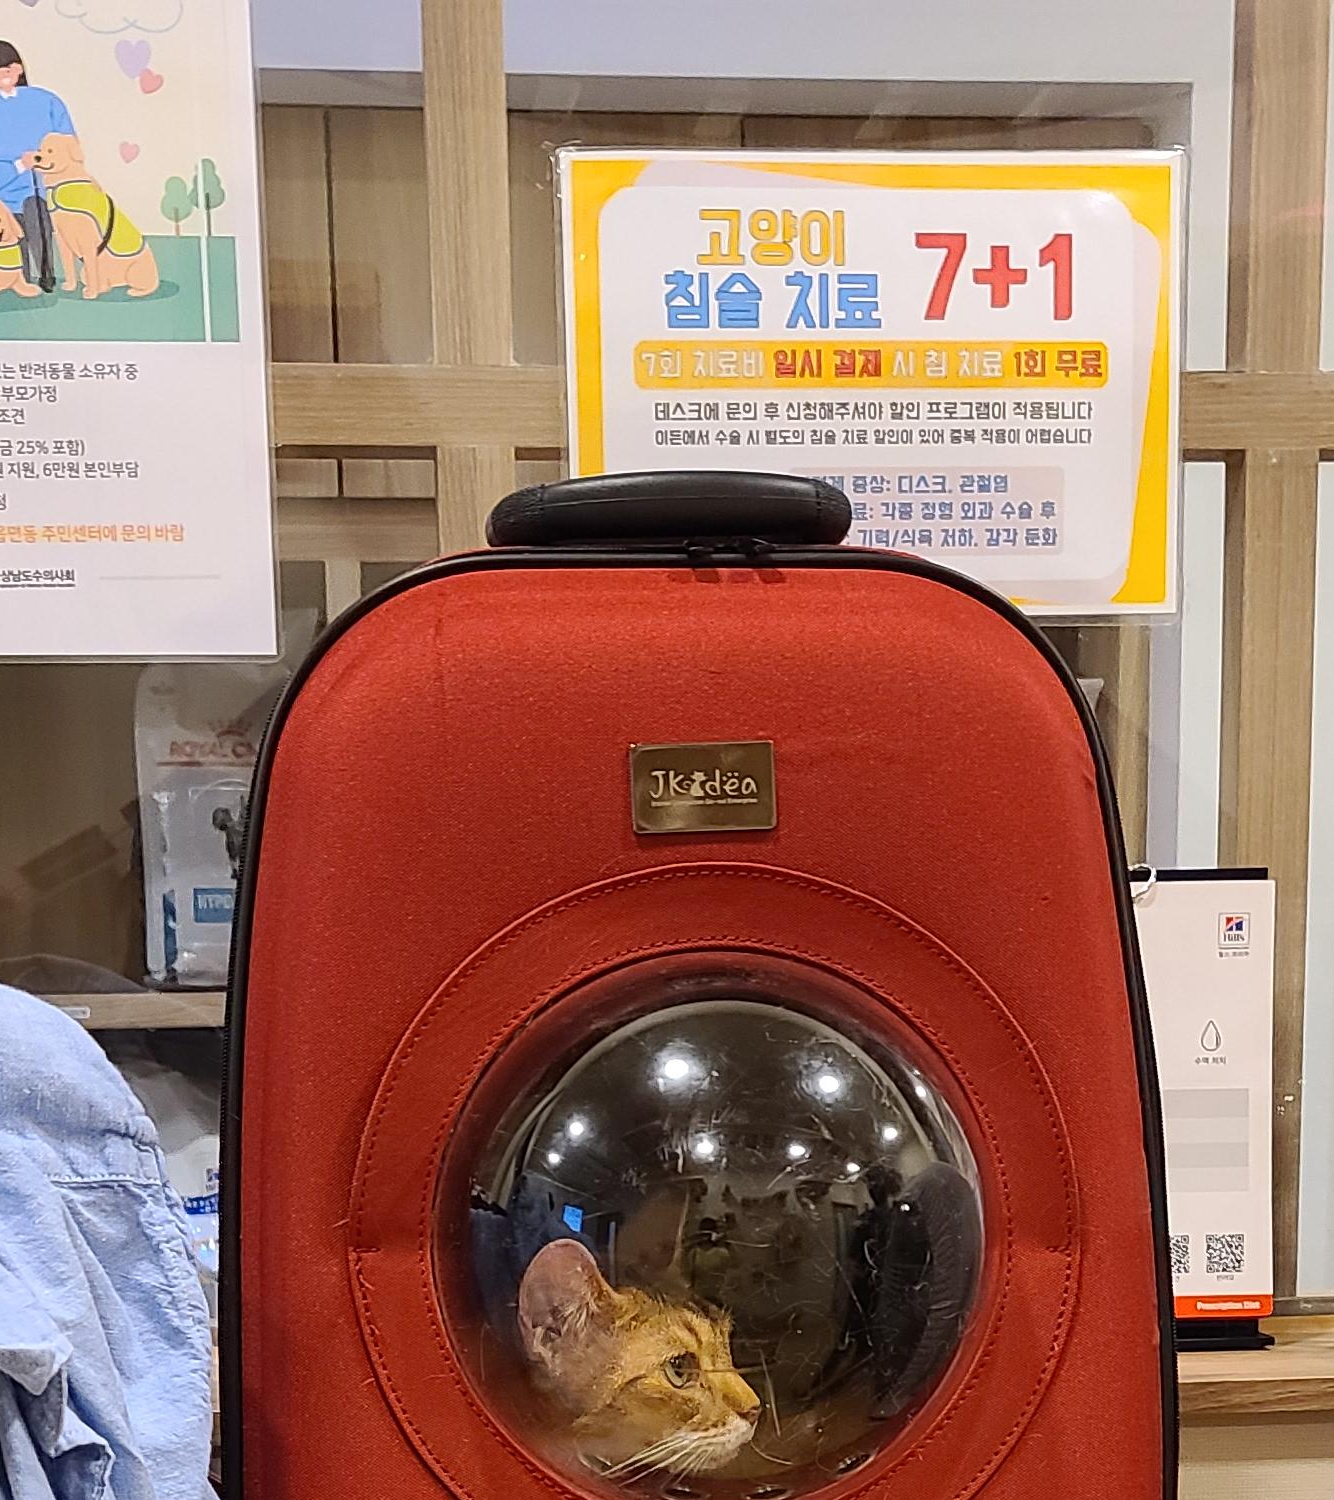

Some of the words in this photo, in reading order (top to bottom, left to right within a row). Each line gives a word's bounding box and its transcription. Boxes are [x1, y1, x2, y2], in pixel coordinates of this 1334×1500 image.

[697, 208, 846, 267] 고양이
[913, 231, 1074, 322] 7+1
[663, 271, 763, 330] 침술
[785, 270, 883, 330] 치료
[19, 362, 76, 380] 반려동물
[78, 363, 121, 380] 소유자
[124, 363, 139, 380] 중
[641, 349, 681, 378] 7회
[692, 349, 764, 378] 치료비
[773, 349, 822, 378] 일시
[833, 349, 882, 378] 결제
[892, 349, 915, 378] 시
[924, 348, 948, 379] 침
[957, 349, 1004, 378] 치료
[1015, 349, 1046, 378] 1회
[1055, 349, 1103, 378] 무료
[654, 402, 719, 421] 데스크에
[726, 402, 758, 421] 문의
[764, 402, 780, 421] 후
[786, 401, 884, 421] 신청해주셔야
[889, 401, 921, 421] 할인
[926, 401, 1007, 421] 프로그램이
[1012, 401, 1093, 421] 적용됩니다
[16, 440, 49, 456] 25%
[52, 440, 86, 457] 포함)
[961, 502, 993, 520] 외과
